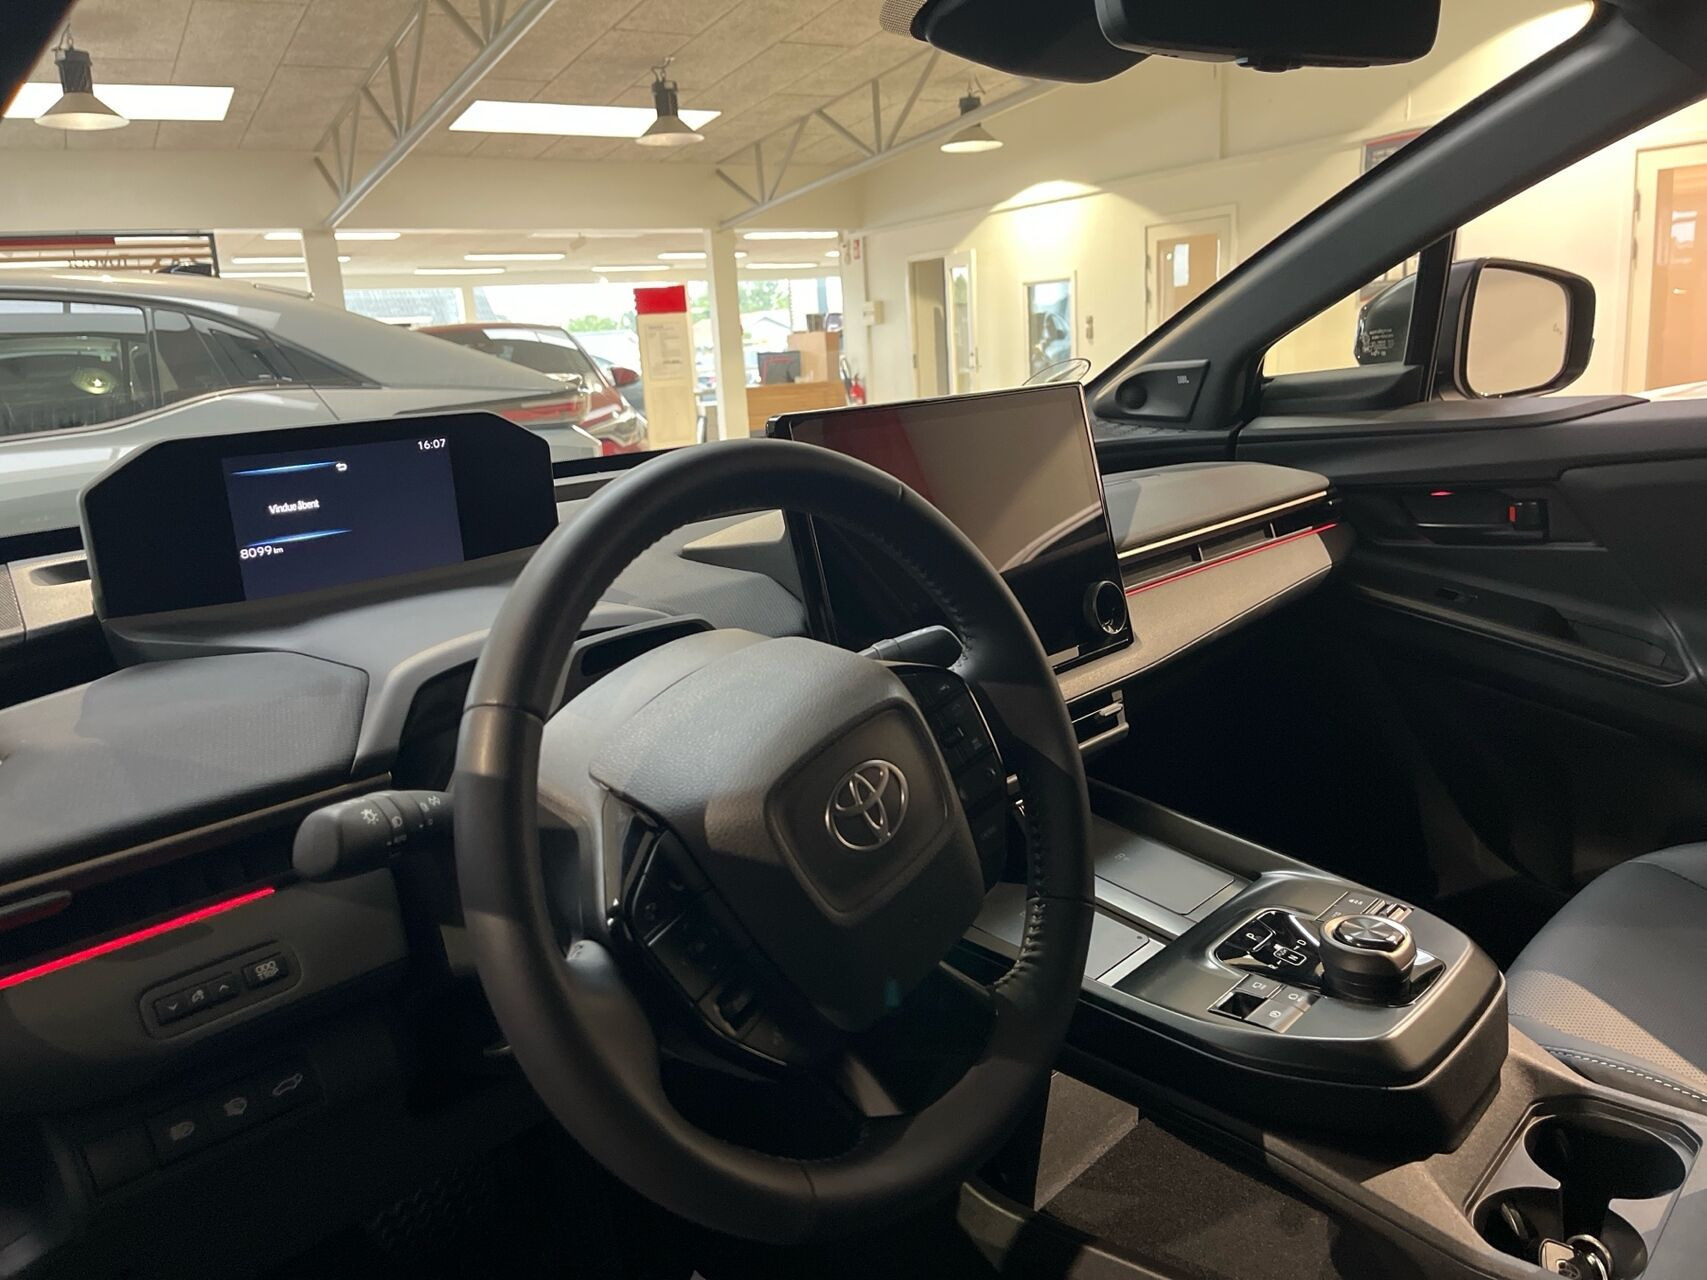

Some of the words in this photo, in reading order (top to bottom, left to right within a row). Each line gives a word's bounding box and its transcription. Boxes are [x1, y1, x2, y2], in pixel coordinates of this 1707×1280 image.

[417, 438, 446, 450] 16:07
[268, 502, 296, 515] Vindue
[240, 545, 272, 560] 8099
[1246, 932, 1257, 941] P
